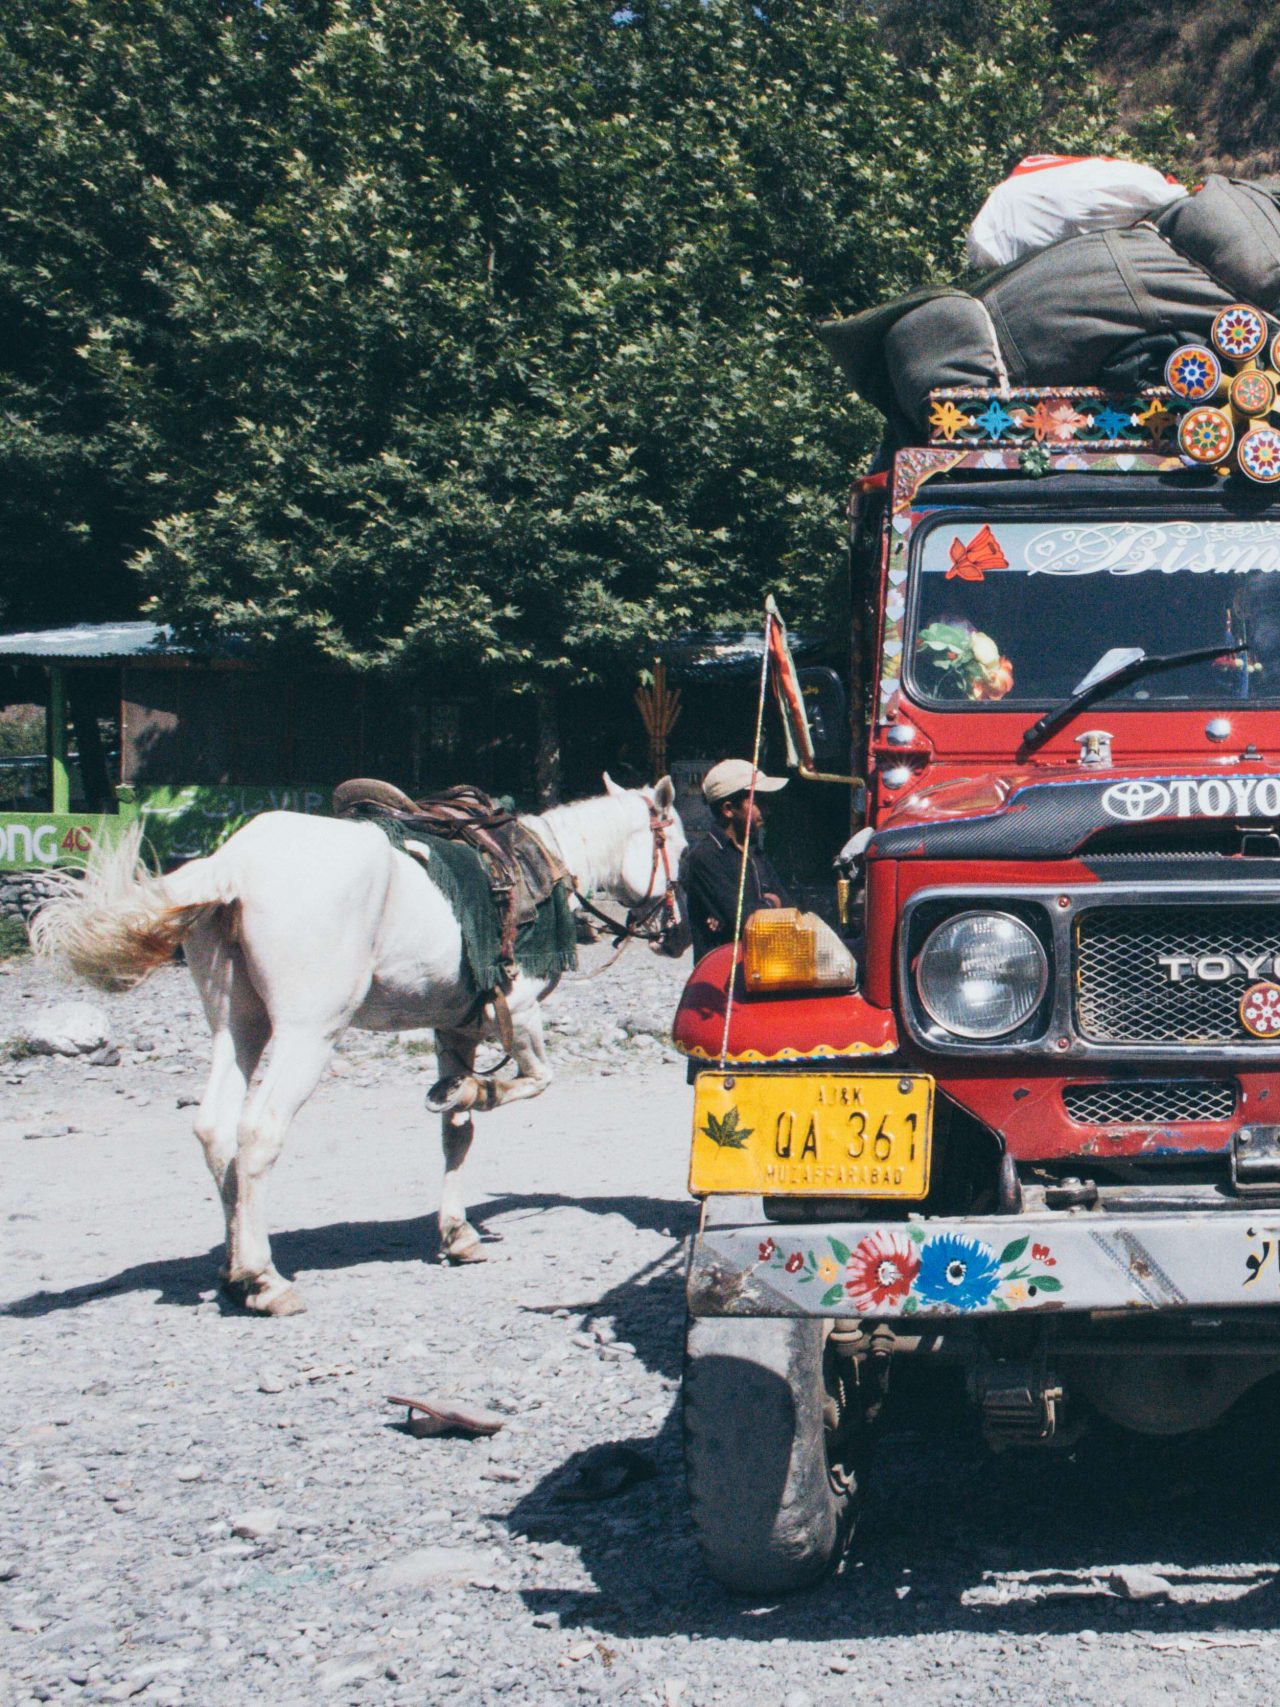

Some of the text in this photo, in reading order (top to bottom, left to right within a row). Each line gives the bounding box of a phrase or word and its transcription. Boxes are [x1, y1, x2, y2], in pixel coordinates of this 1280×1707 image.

[775, 1111, 919, 1163] QA 361
[765, 1165, 906, 1186] MUZAFFARABAD
